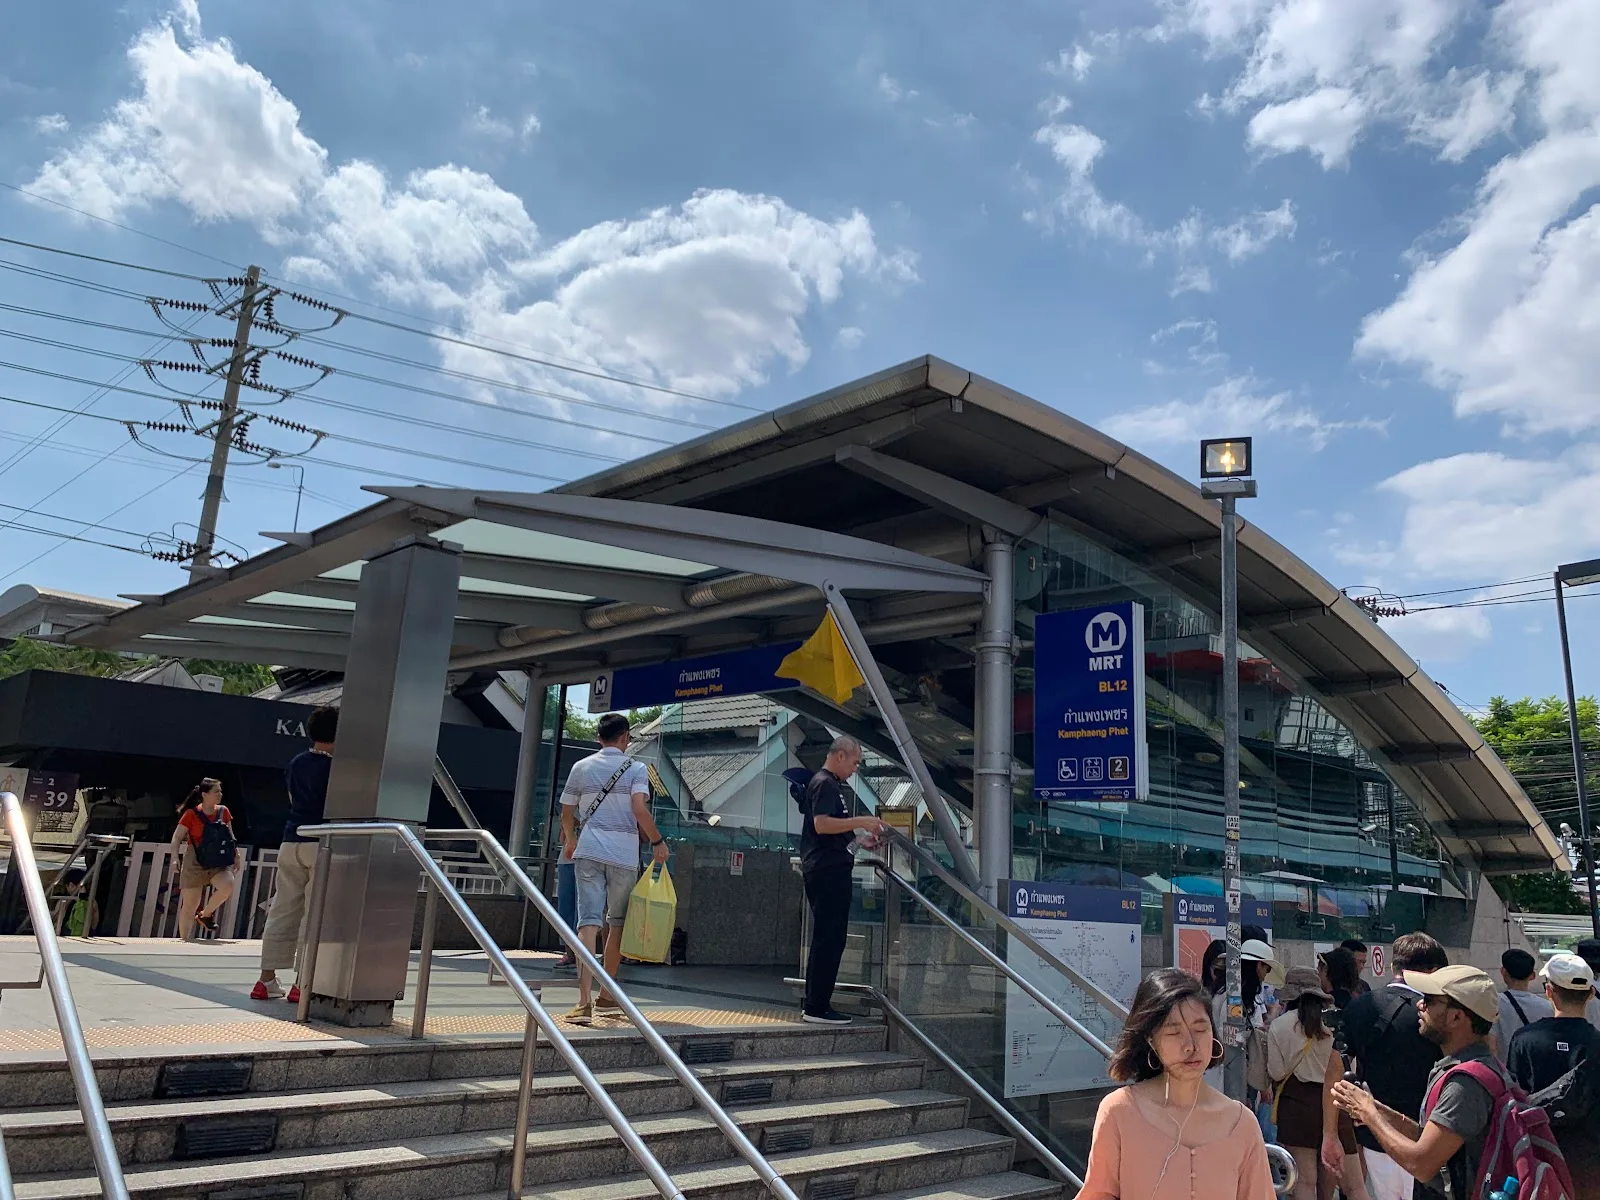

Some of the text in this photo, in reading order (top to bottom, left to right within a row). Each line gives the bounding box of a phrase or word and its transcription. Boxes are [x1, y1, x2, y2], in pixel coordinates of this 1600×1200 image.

[1089, 655, 1123, 671] MRT
[679, 668, 721, 683] กำแพงเพชร
[674, 684, 723, 697] Kamphaeng Phet
[1099, 680, 1127, 692] BL12
[1064, 708, 1128, 724] กำแพงเพชร
[275, 719, 306, 737] KA
[1058, 726, 1129, 739] Kamphaeng Phet
[1114, 759, 1123, 772] 2
[48, 778, 55, 786] 2
[44, 791, 68, 807] 39
[1030, 890, 1065, 904] กำแพงเพชร
[1016, 907, 1028, 915] MRT
[1121, 900, 1136, 910] BL12
[1030, 908, 1057, 918] Kamphaeng
[1256, 908, 1268, 916] BL12
